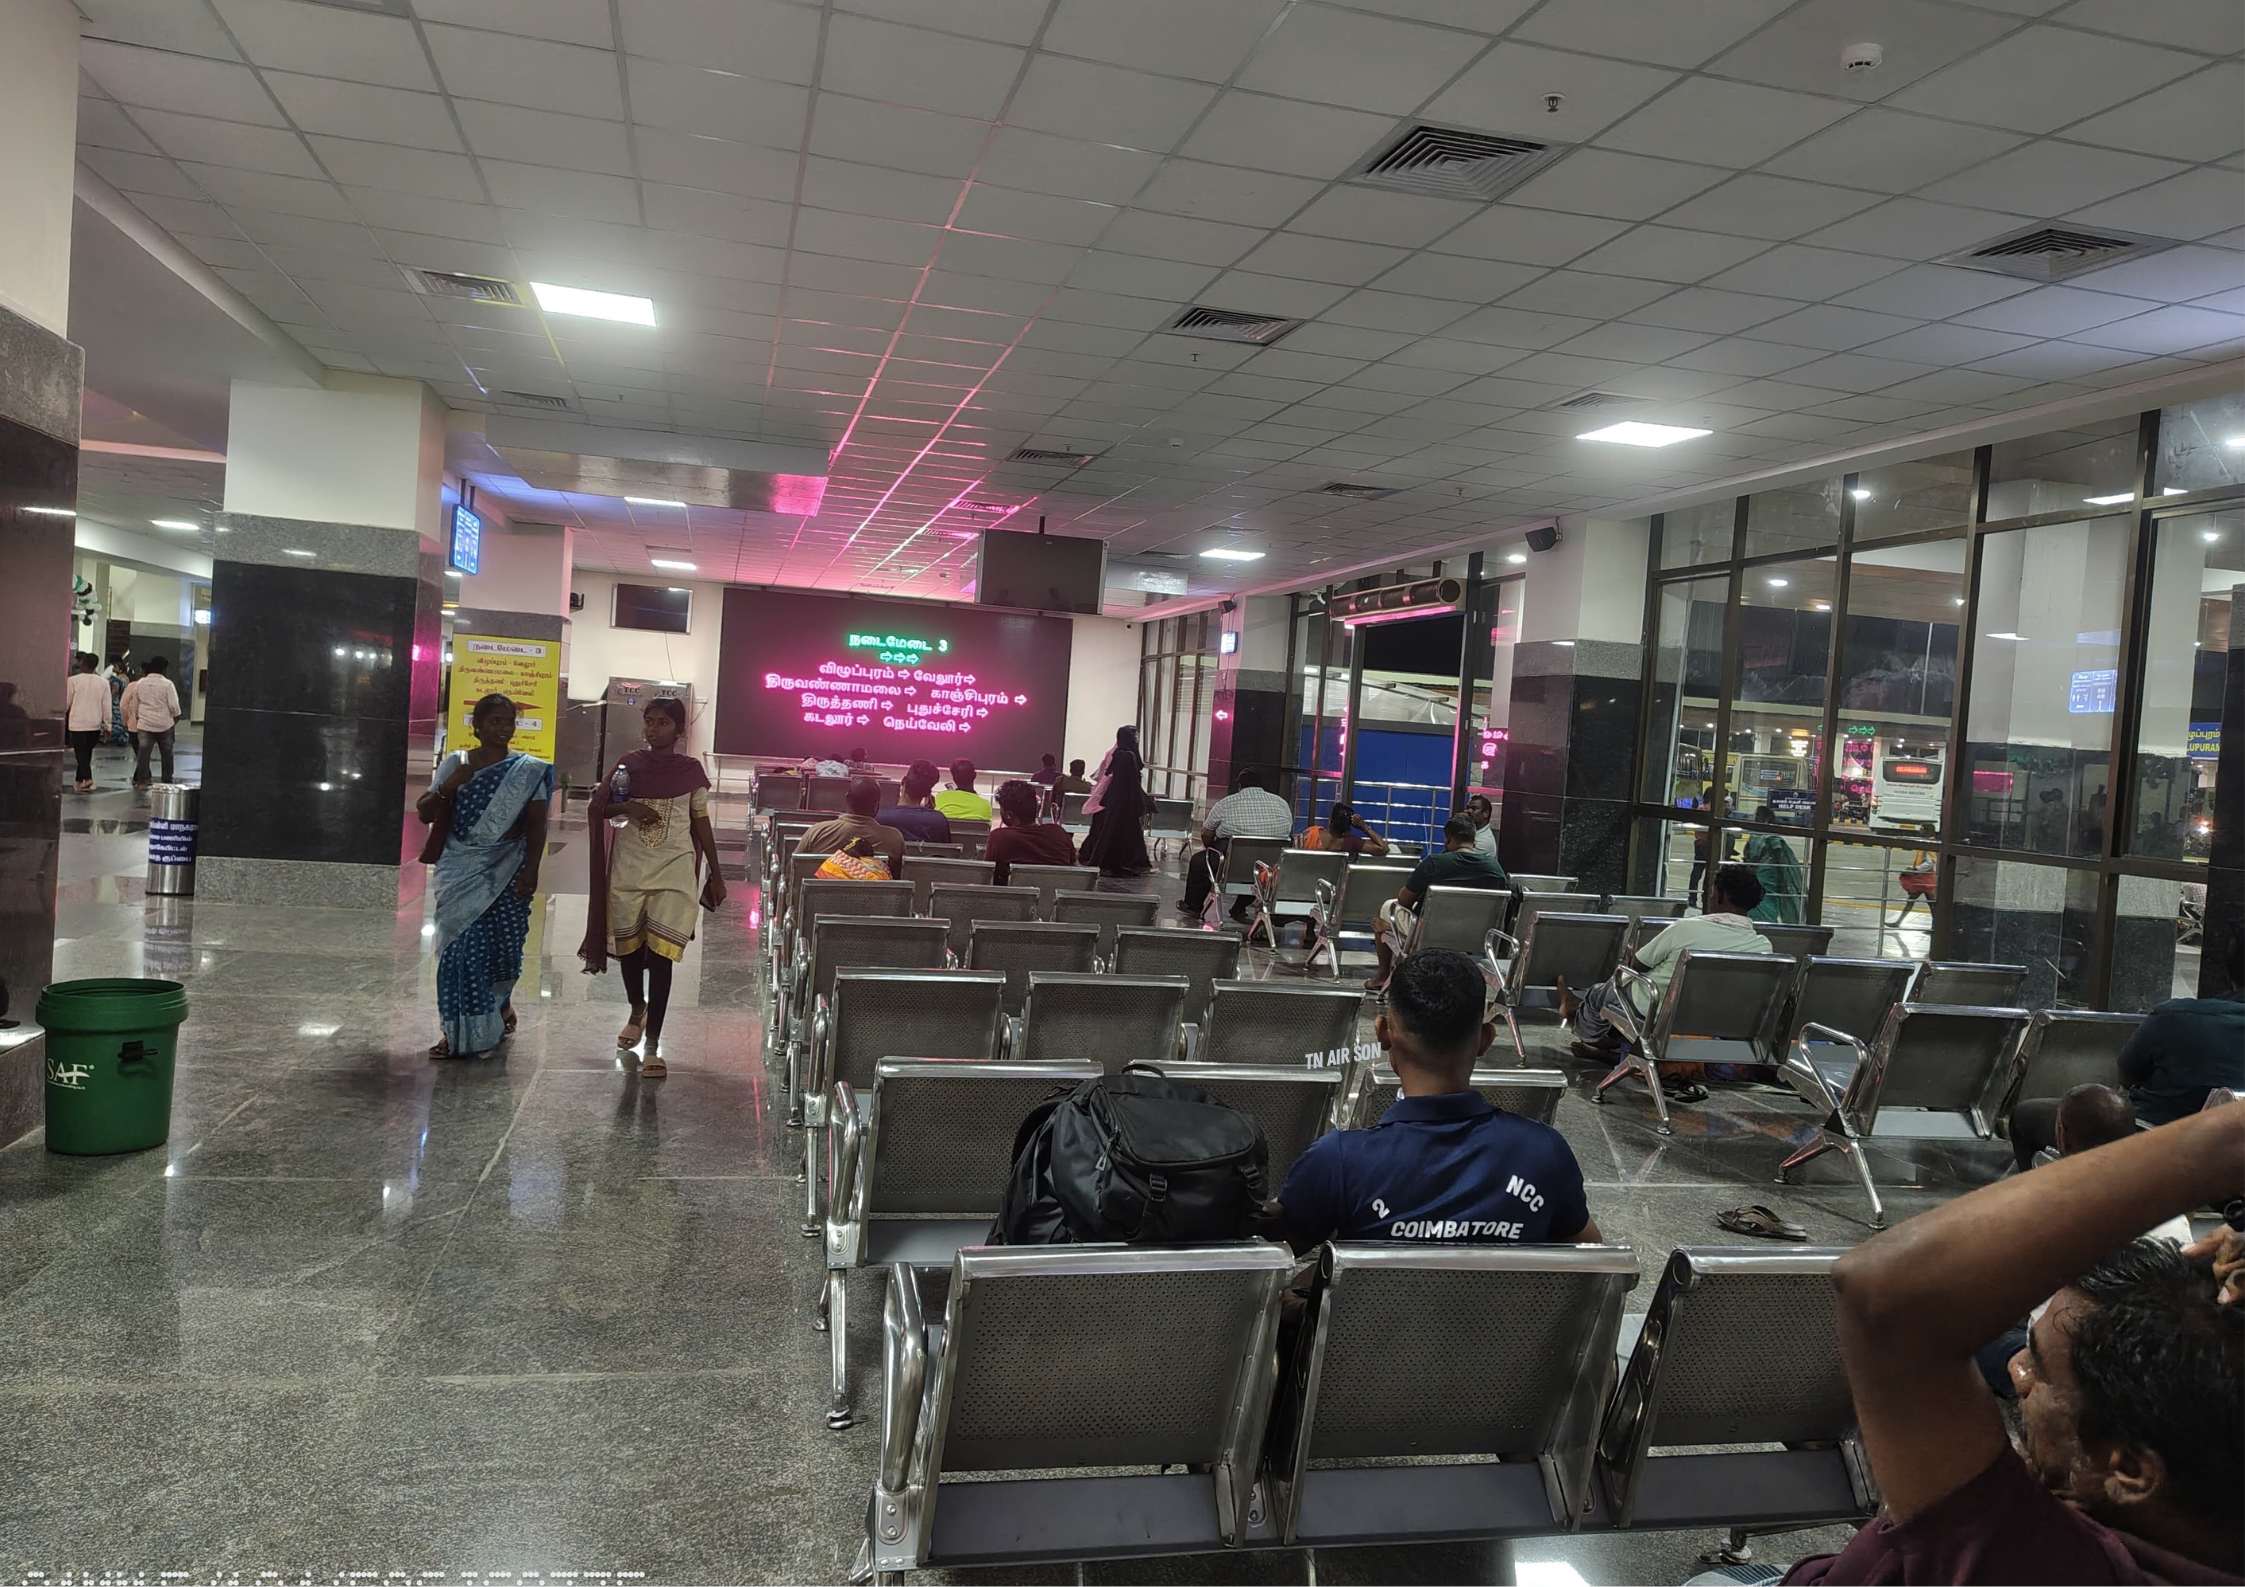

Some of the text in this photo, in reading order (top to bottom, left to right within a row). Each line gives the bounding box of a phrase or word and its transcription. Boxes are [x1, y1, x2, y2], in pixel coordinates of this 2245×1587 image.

[849, 634, 948, 652] நடைமேடை 3
[819, 661, 964, 686] விழுப்புரம் வேலூர்
[765, 673, 1009, 705] திருவண்ணாமலை காஞ்சிபுரம்
[801, 692, 973, 719] திருத்தணி புதுச்சேரி
[804, 712, 956, 732] கடலூர் நெய்வேலி
[1305, 1051, 1324, 1070] TN
[1326, 1047, 1351, 1067] AIR
[1505, 1174, 1545, 1213] NCC
[1371, 1198, 1390, 1219] 2
[1390, 1220, 1524, 1239] COIMBATORE
